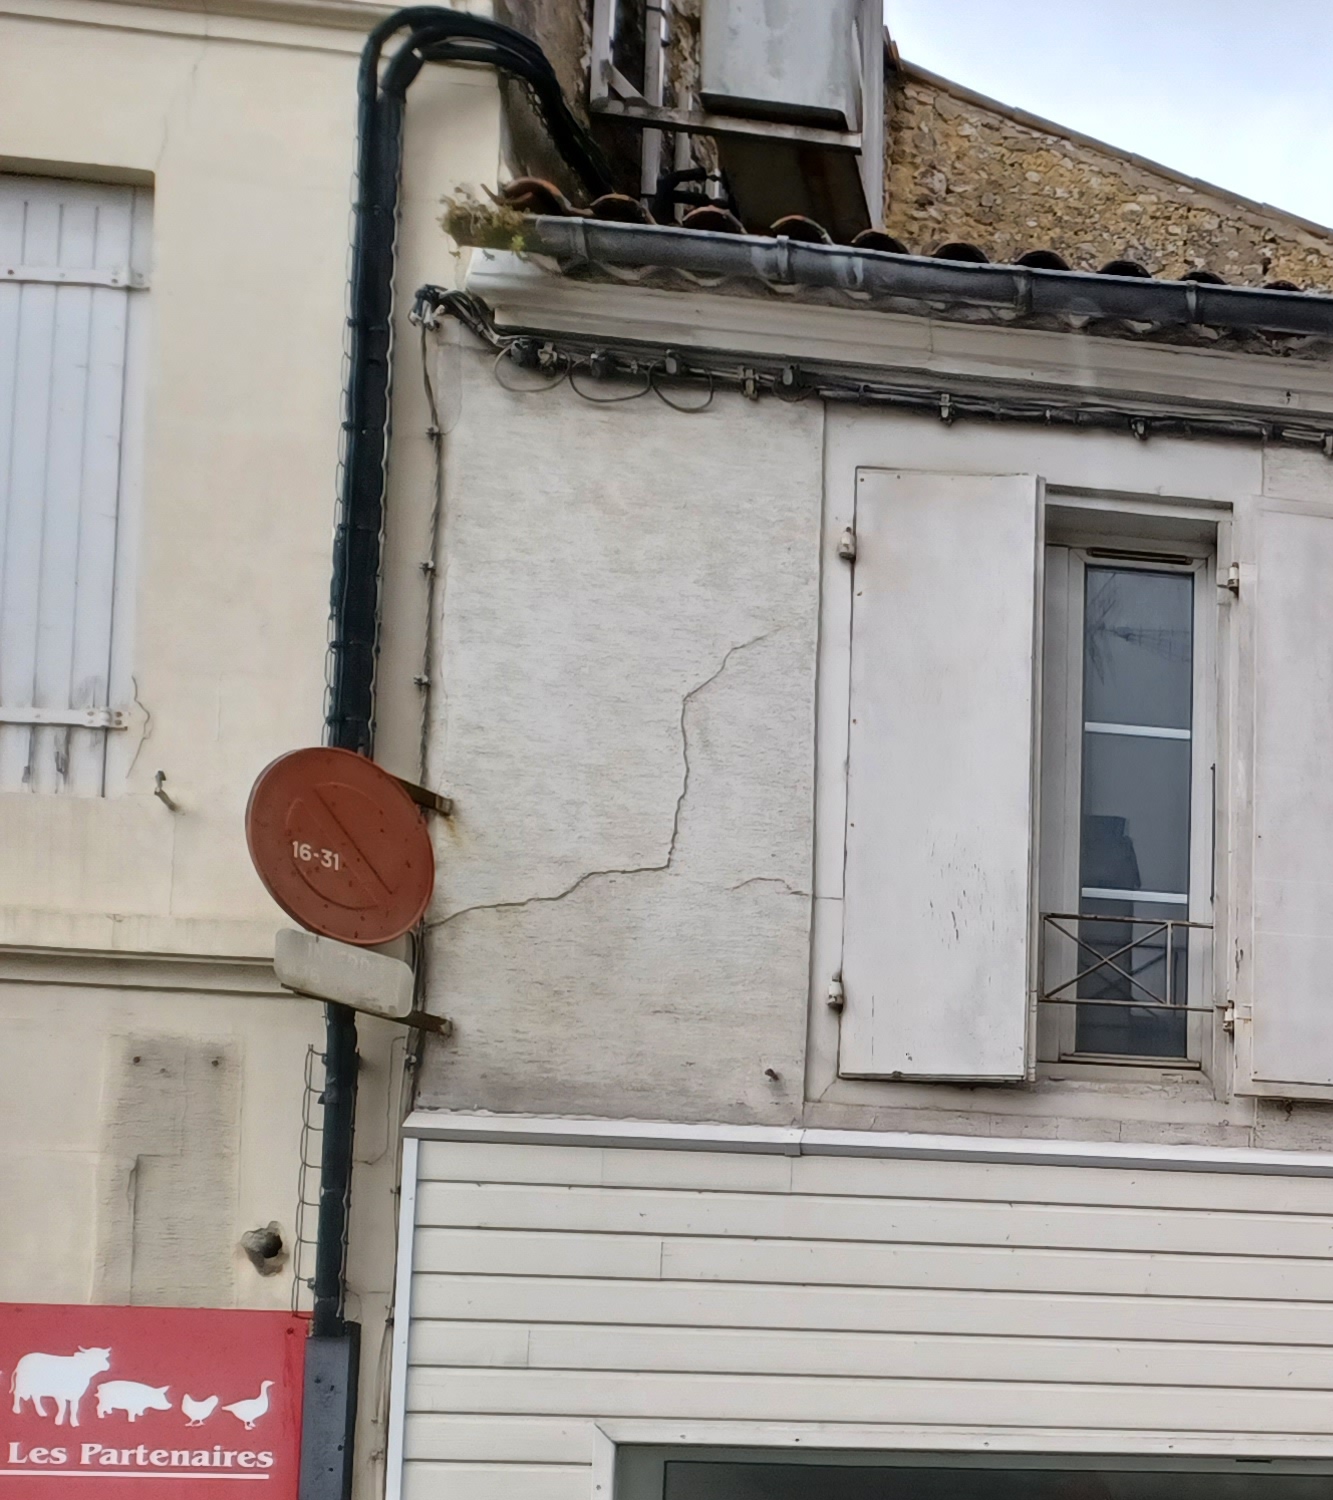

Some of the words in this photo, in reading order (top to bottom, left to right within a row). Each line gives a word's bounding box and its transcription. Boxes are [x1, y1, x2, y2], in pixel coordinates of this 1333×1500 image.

[292, 840, 340, 871] 16-31
[8, 1442, 67, 1465] Les
[79, 1443, 274, 1468] Partenaires
